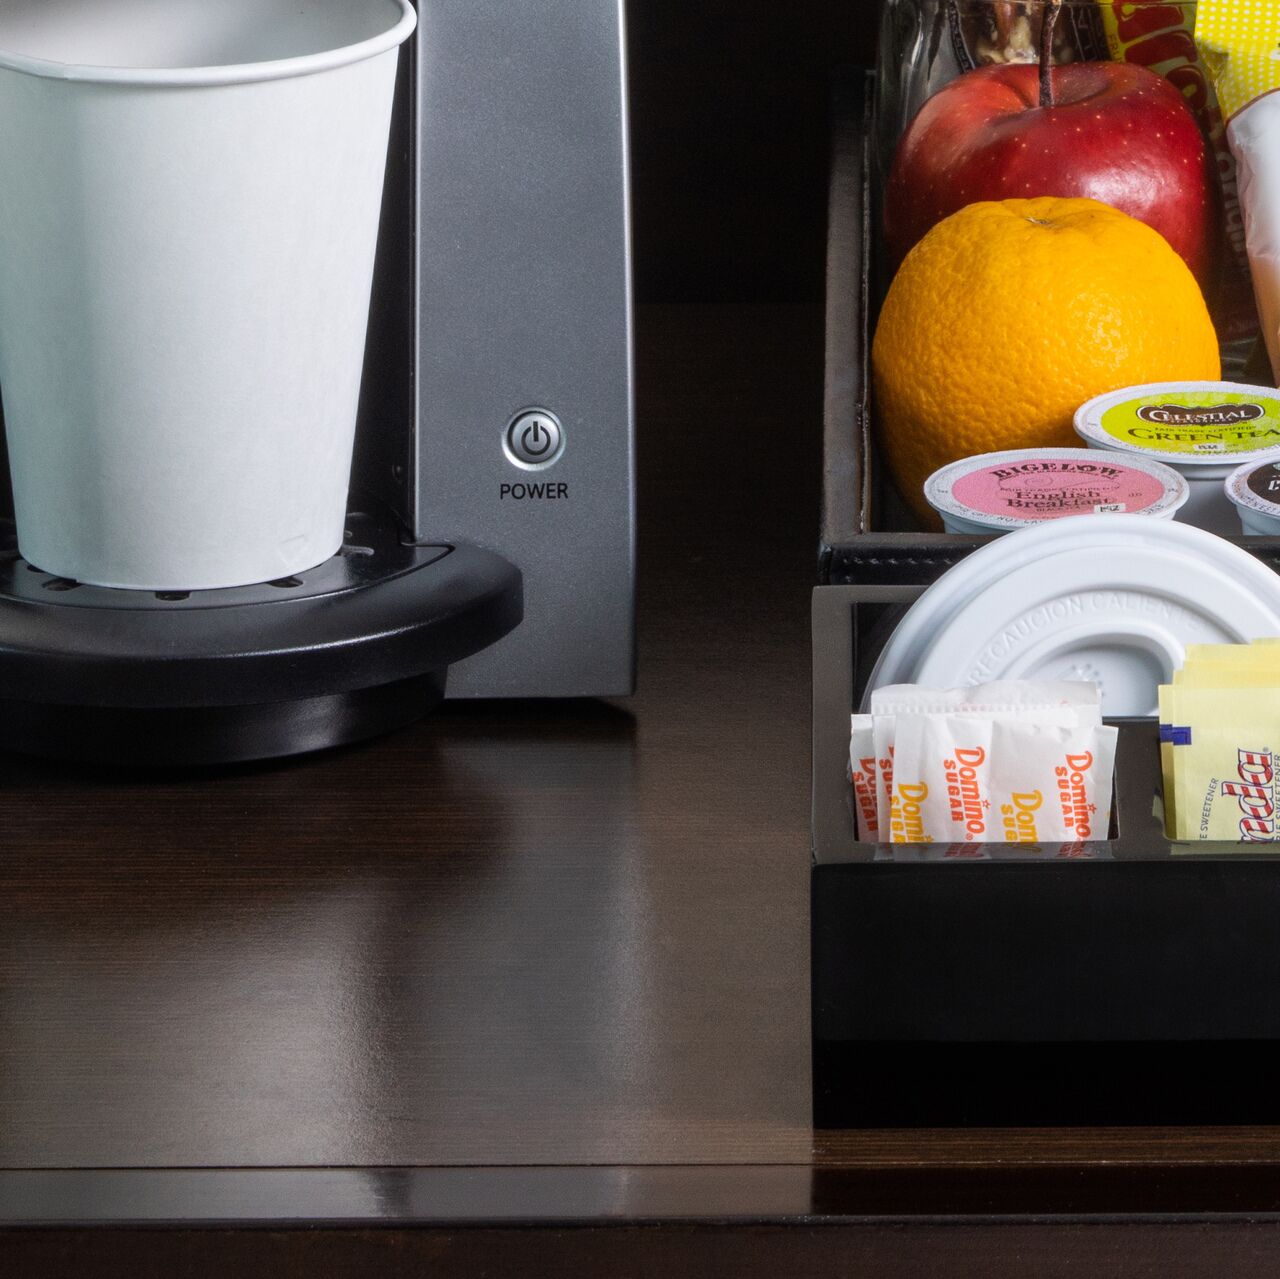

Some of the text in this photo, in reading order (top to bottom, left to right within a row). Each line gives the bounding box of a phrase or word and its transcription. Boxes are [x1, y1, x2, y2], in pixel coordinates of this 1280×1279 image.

[1149, 409, 1252, 421] CELESTIAL
[1128, 427, 1223, 441] GREEN
[989, 462, 1125, 478] BIGELOW
[500, 482, 569, 500] POWER
[1015, 490, 1101, 501] English
[1006, 497, 1112, 509] Breakfast
[943, 758, 964, 823] SUGAR
[955, 745, 986, 836] Domino
[1055, 765, 1075, 828] SUGAR
[1065, 750, 1094, 839] Domino
[1200, 777, 1219, 832] SWEETENER
